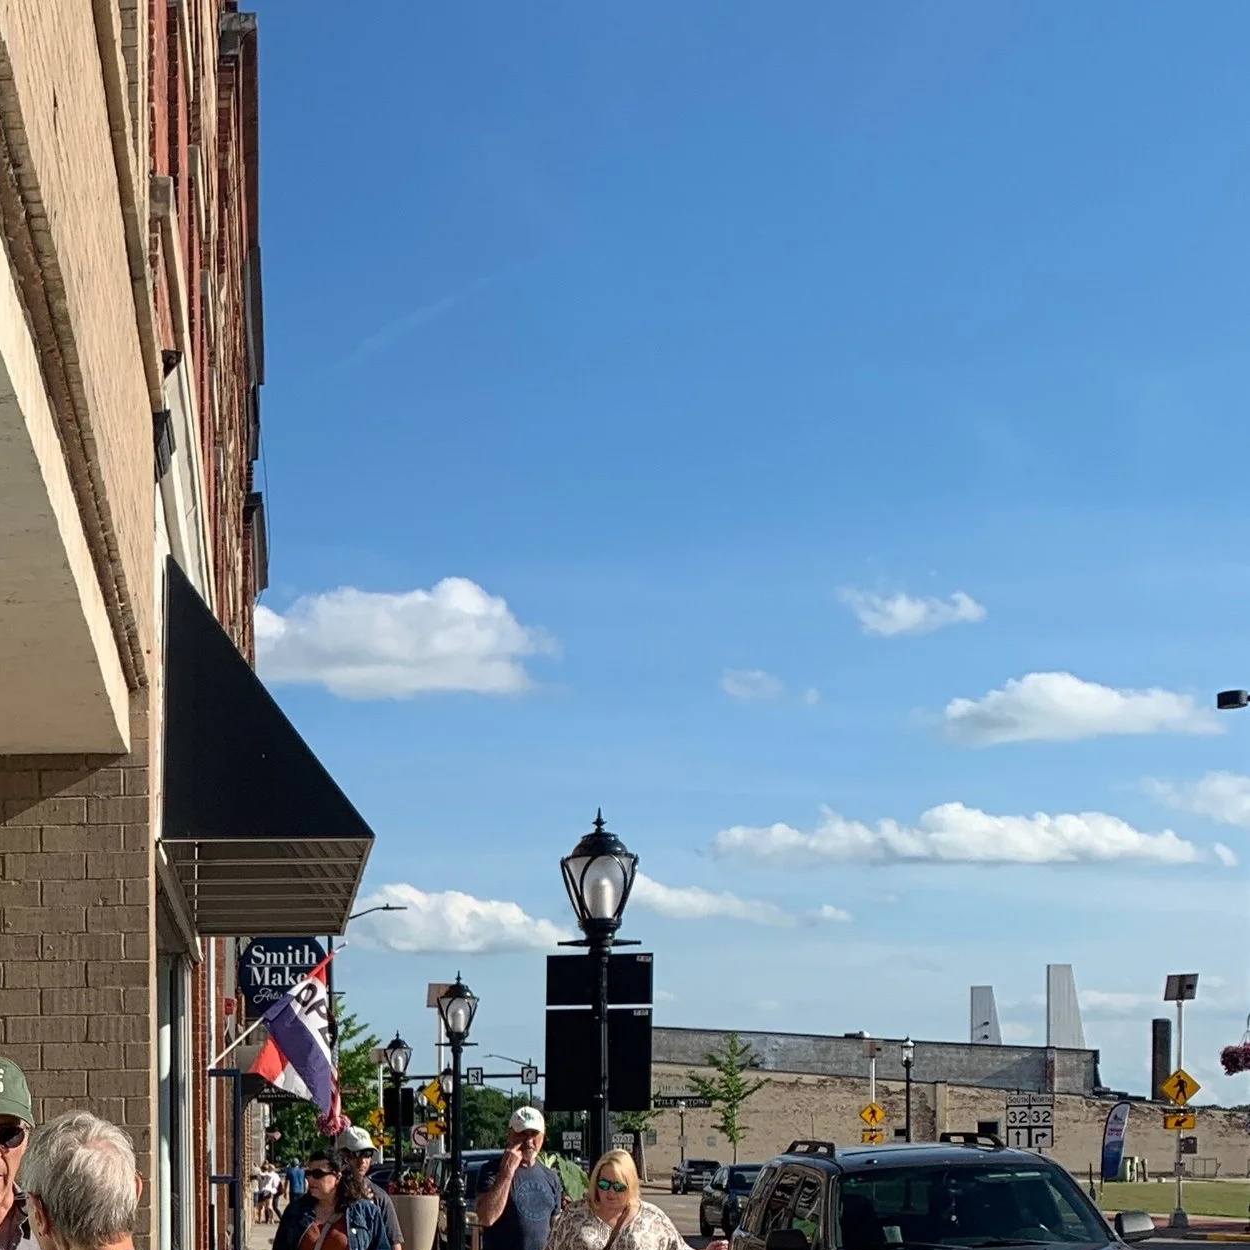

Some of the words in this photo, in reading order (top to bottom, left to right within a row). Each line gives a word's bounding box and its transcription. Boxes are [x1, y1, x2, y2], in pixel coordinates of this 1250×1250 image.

[250, 945, 317, 965] Smith
[1009, 1111, 1028, 1124] 32
[1031, 1111, 1051, 1124] 32
